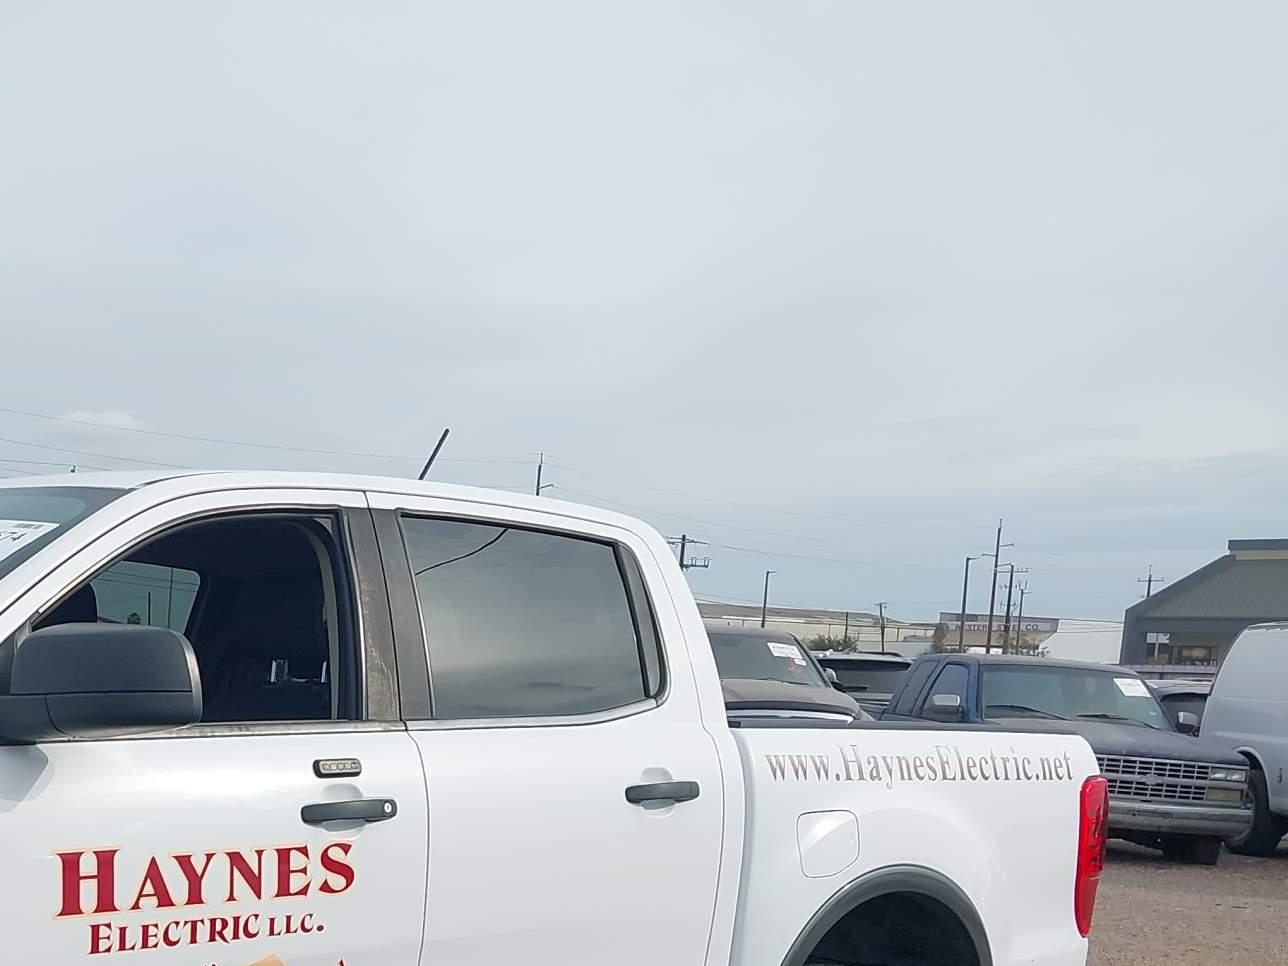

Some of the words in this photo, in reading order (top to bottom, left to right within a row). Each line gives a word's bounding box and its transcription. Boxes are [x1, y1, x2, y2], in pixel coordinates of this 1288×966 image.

[764, 744, 1074, 789] www.HaynesElectric.net
[54, 841, 358, 919] HAYNES
[88, 912, 261, 955] ELECTRIC
[267, 913, 326, 937] LLC.
